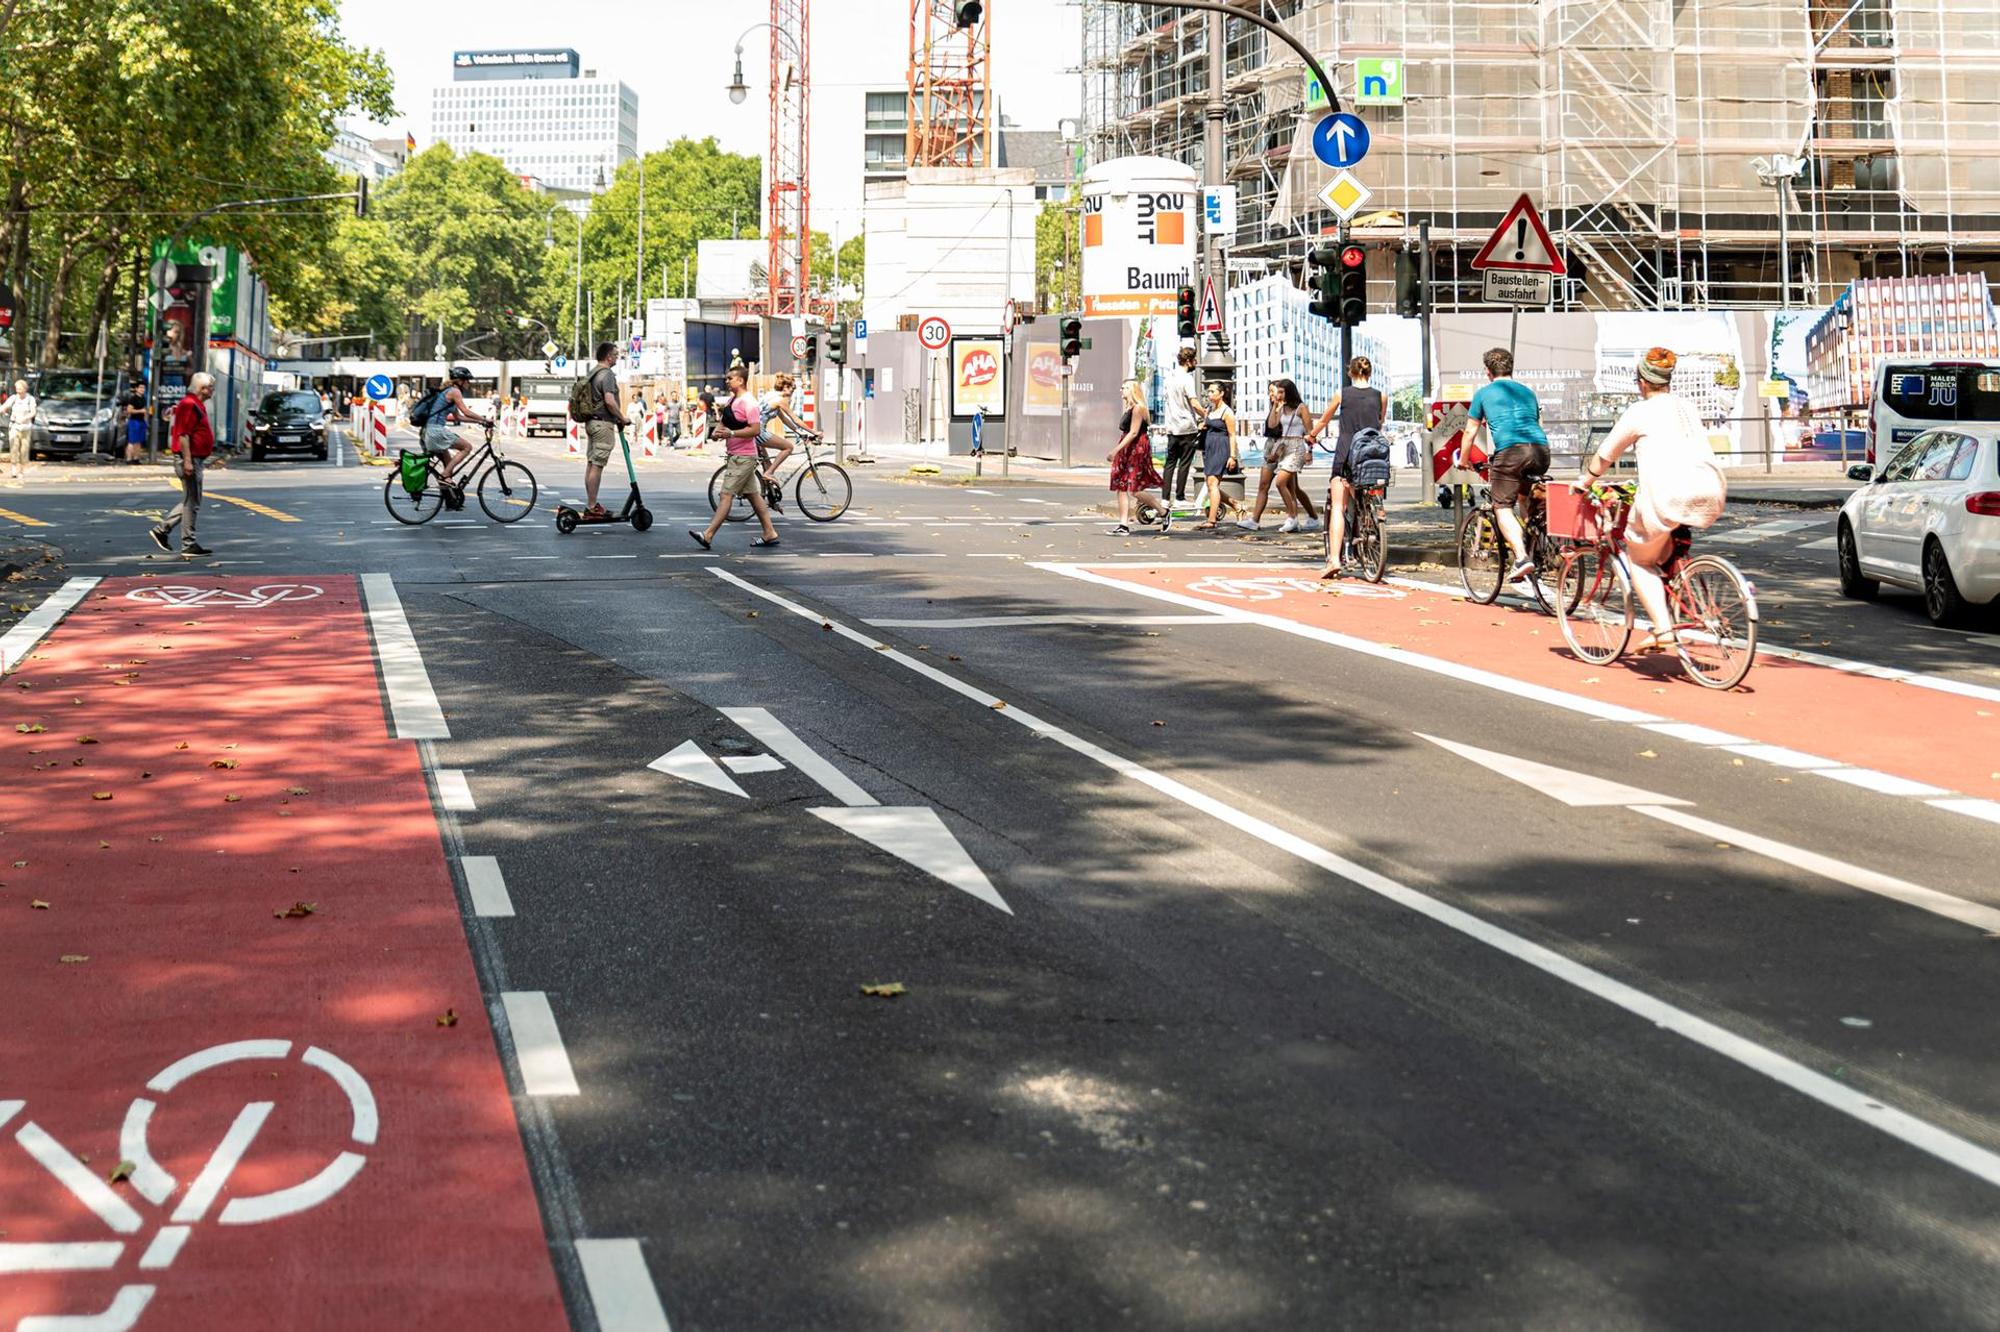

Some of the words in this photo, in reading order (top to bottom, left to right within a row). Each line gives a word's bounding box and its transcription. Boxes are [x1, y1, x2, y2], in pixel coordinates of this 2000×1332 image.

[1127, 266, 1190, 290] Baumit
[1491, 273, 1545, 287] Baustellen-
[1498, 287, 1537, 300] ausfahrt
[925, 325, 946, 341] 30
[963, 353, 998, 378] AHA
[1928, 387, 1957, 406] JU
